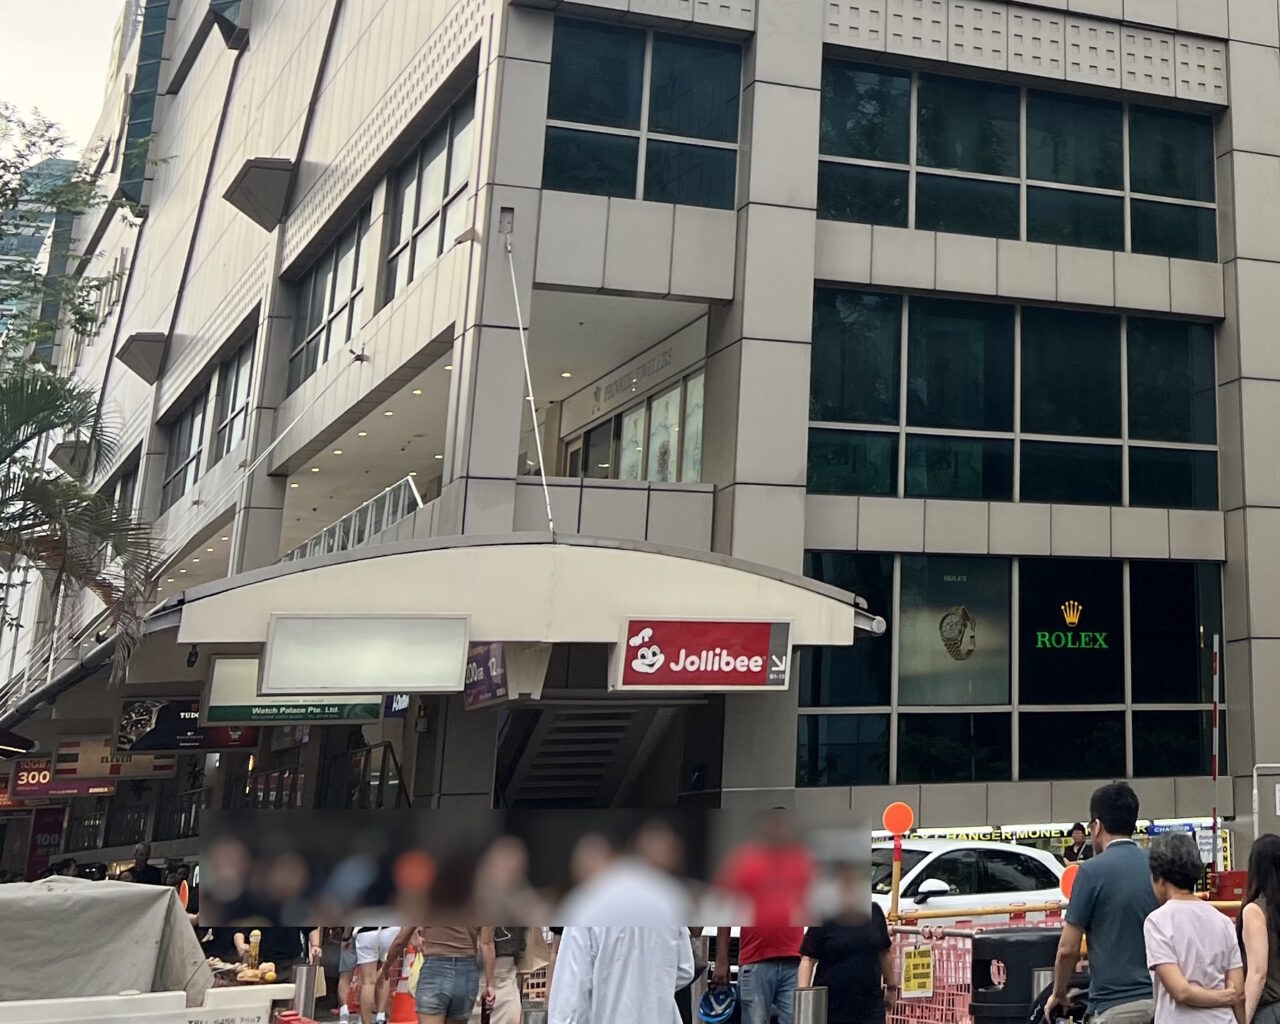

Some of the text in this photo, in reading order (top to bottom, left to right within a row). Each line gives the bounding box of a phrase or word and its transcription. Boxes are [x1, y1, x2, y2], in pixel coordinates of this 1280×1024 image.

[1035, 631, 1110, 649] ROLEX
[669, 647, 763, 672] Jollibee
[17, 771, 50, 785] 300
[1016, 828, 1070, 839] MONEY
